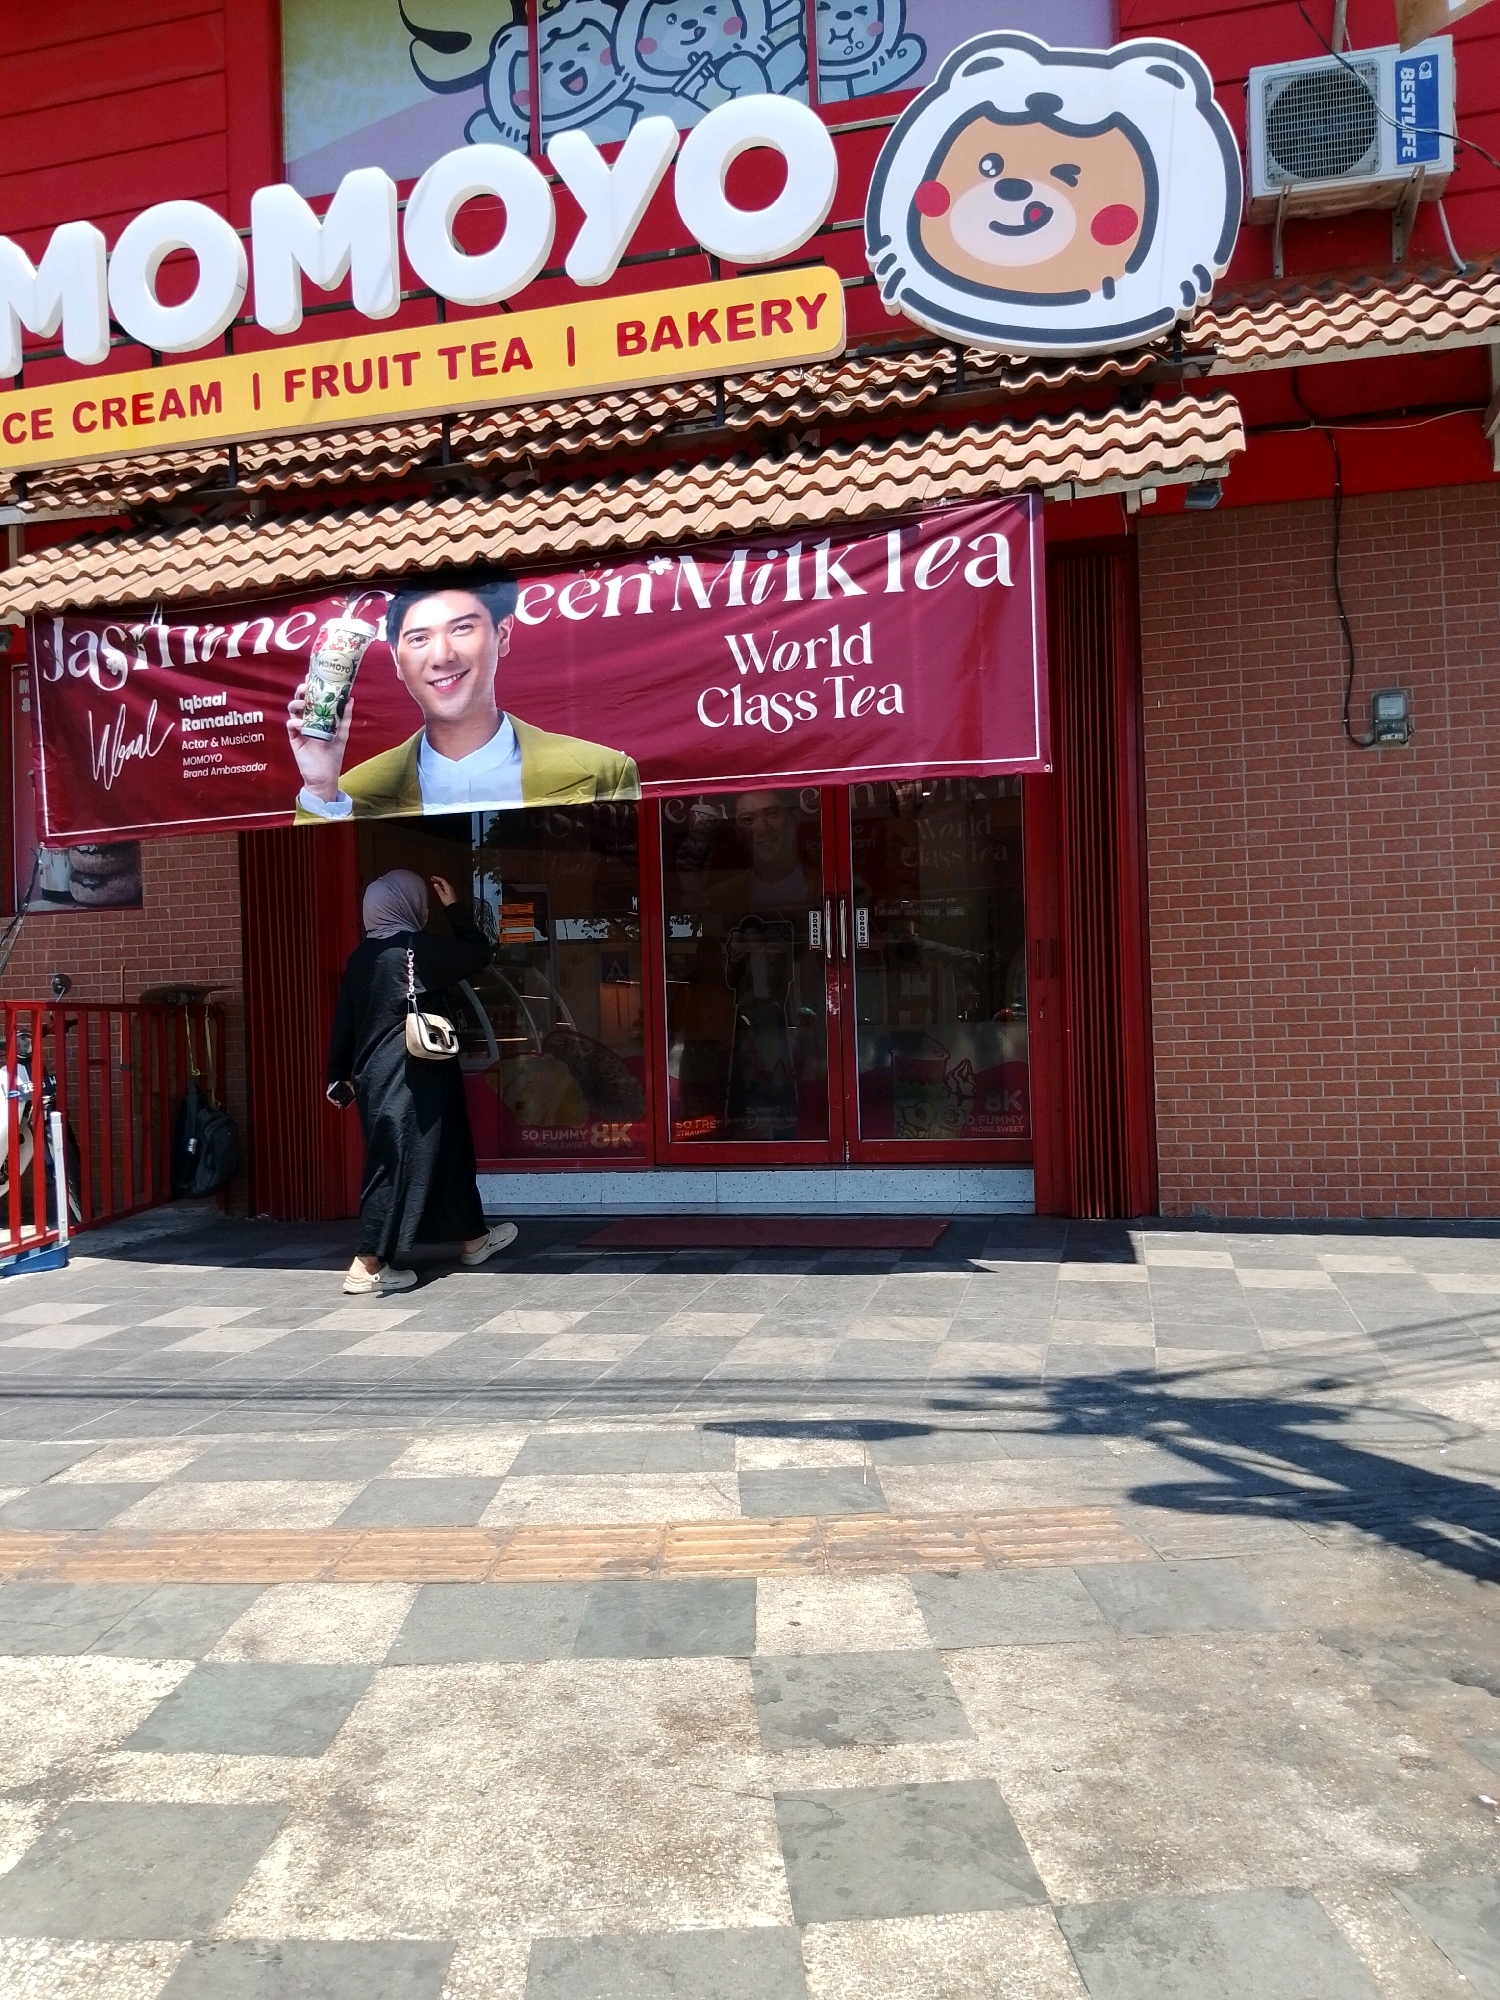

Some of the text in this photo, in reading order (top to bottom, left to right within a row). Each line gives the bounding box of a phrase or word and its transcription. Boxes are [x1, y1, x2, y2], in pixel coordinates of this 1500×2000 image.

[1401, 67, 1417, 158] BESTLIFE
[0, 94, 837, 378] MOMOYO
[73, 381, 223, 432] CREAM
[284, 351, 421, 403] FRUIT
[438, 337, 532, 380] TEA
[617, 293, 827, 356] BAKERY
[671, 537, 868, 611] Milk
[868, 523, 1015, 592] Tea
[724, 622, 873, 675] World
[318, 660, 351, 674] MOMOYO
[179, 691, 227, 714] Iqbaal
[696, 676, 904, 734] Class Tea
[181, 710, 263, 732] Ramadhan
[181, 733, 265, 750] Actor & Musician
[182, 753, 222, 766] MOMOYO
[183, 763, 267, 779] Brand Ambassador
[985, 1089, 1023, 1111] 8K
[521, 1121, 634, 1148] SO FUMMY 8K
